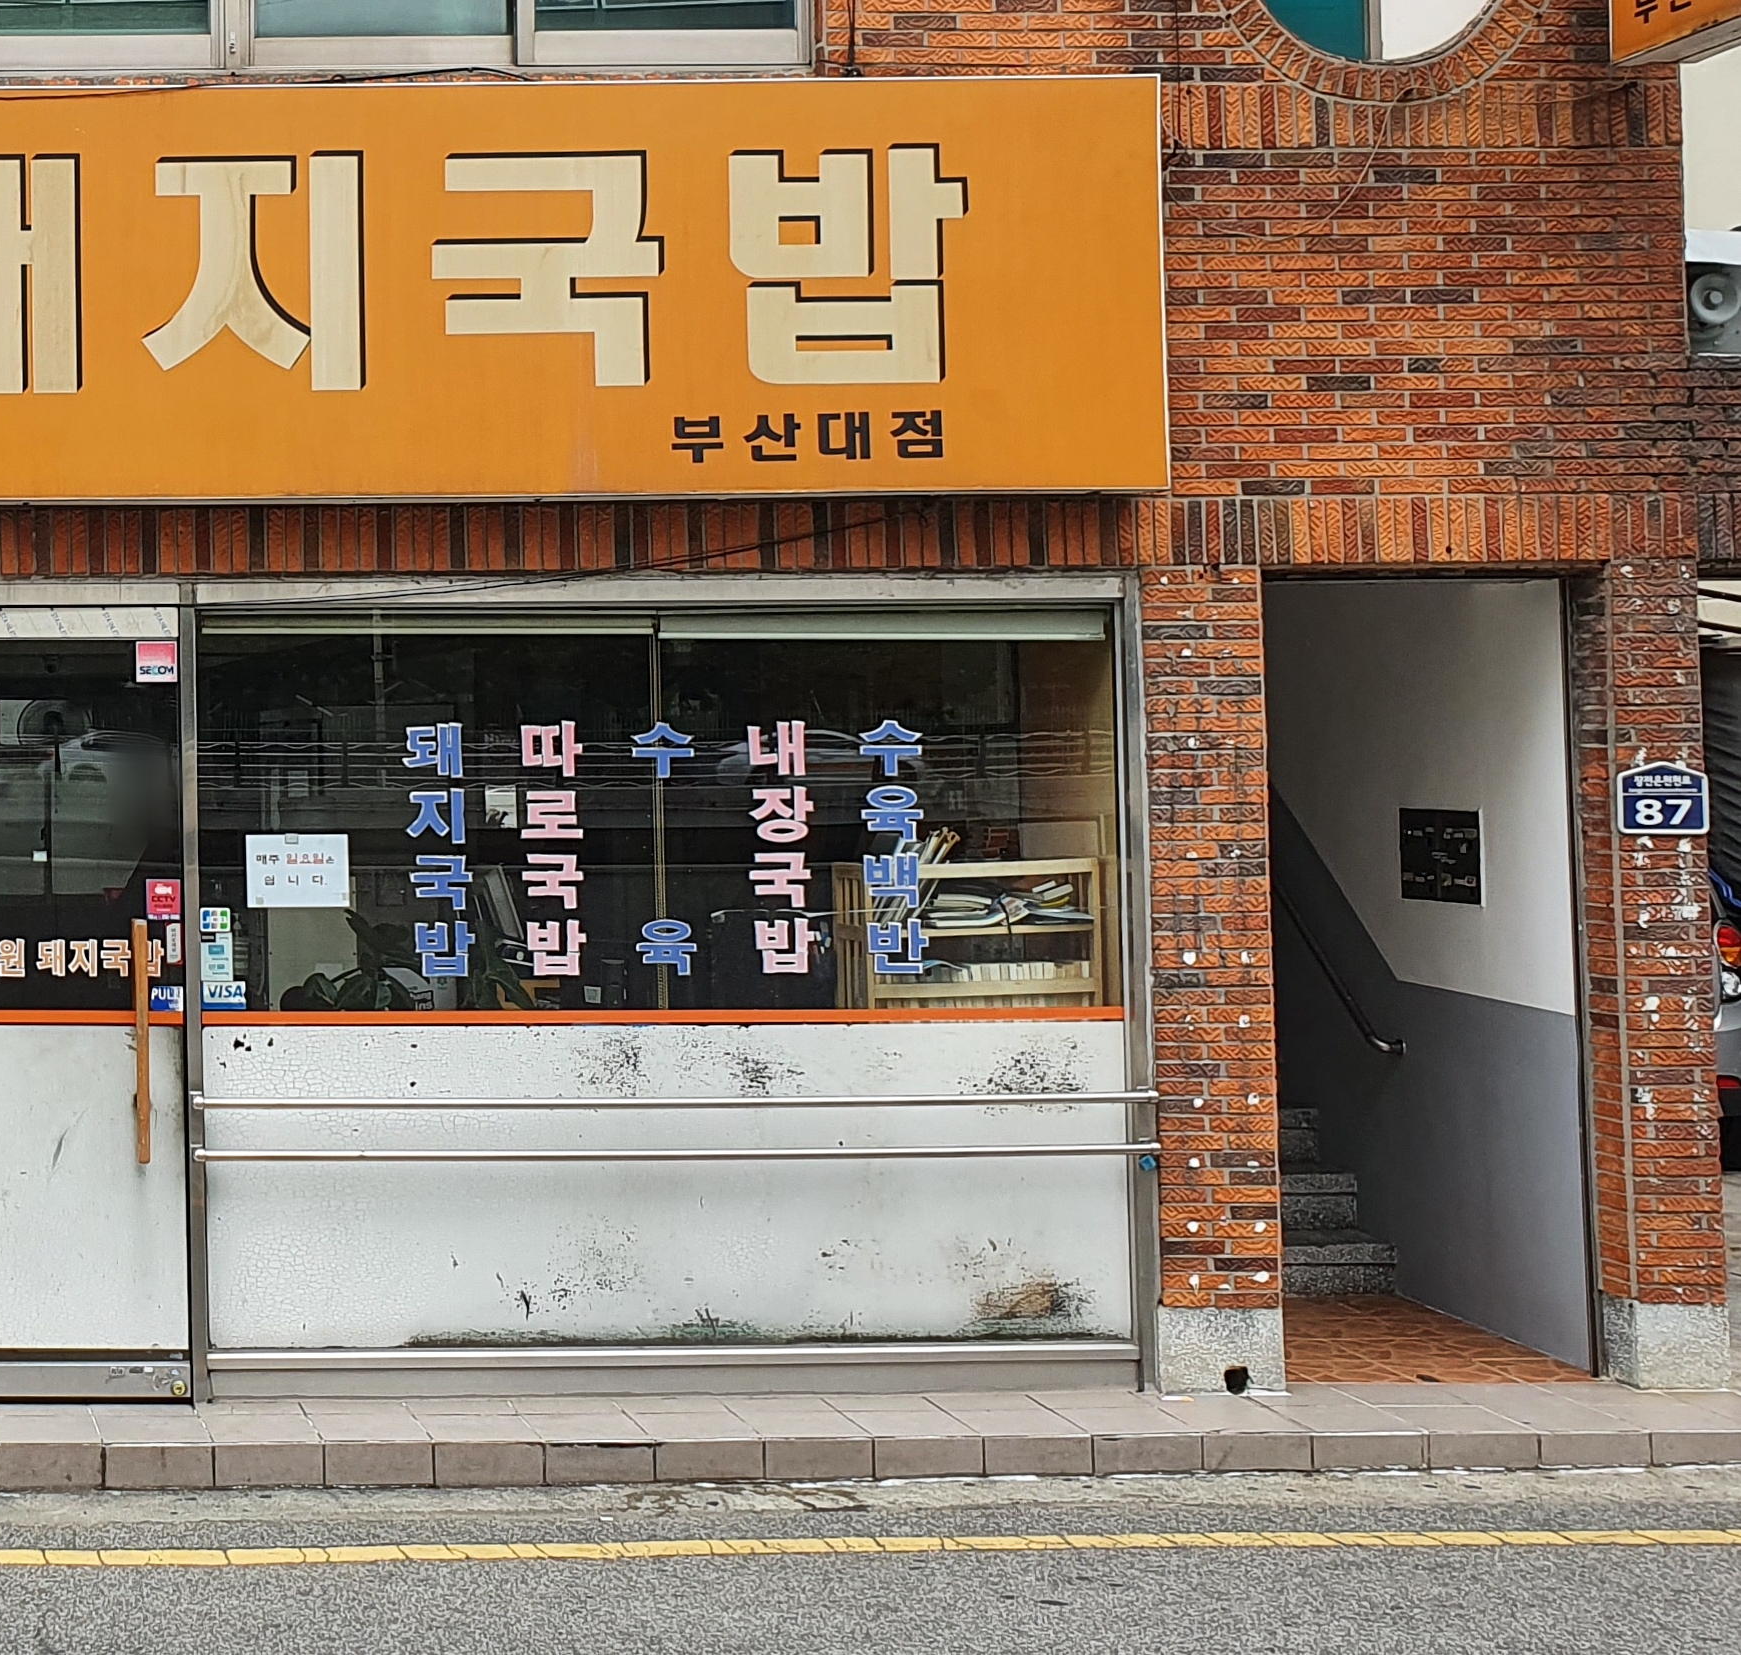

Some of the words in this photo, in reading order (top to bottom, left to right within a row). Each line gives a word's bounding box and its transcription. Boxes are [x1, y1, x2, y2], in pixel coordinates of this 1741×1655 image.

[671, 409, 944, 464] 부산대점
[139, 665, 174, 676] SECOM
[1634, 798, 1693, 826] 87
[255, 853, 280, 865] 매주
[402, 721, 476, 978] 돼지국밥
[519, 720, 587, 979] 따로국밥
[631, 721, 698, 977] 수육
[746, 720, 816, 976] 내장국밥
[859, 719, 930, 976] 수육백반
[151, 895, 176, 903] CCTV
[207, 984, 244, 999] VISA
